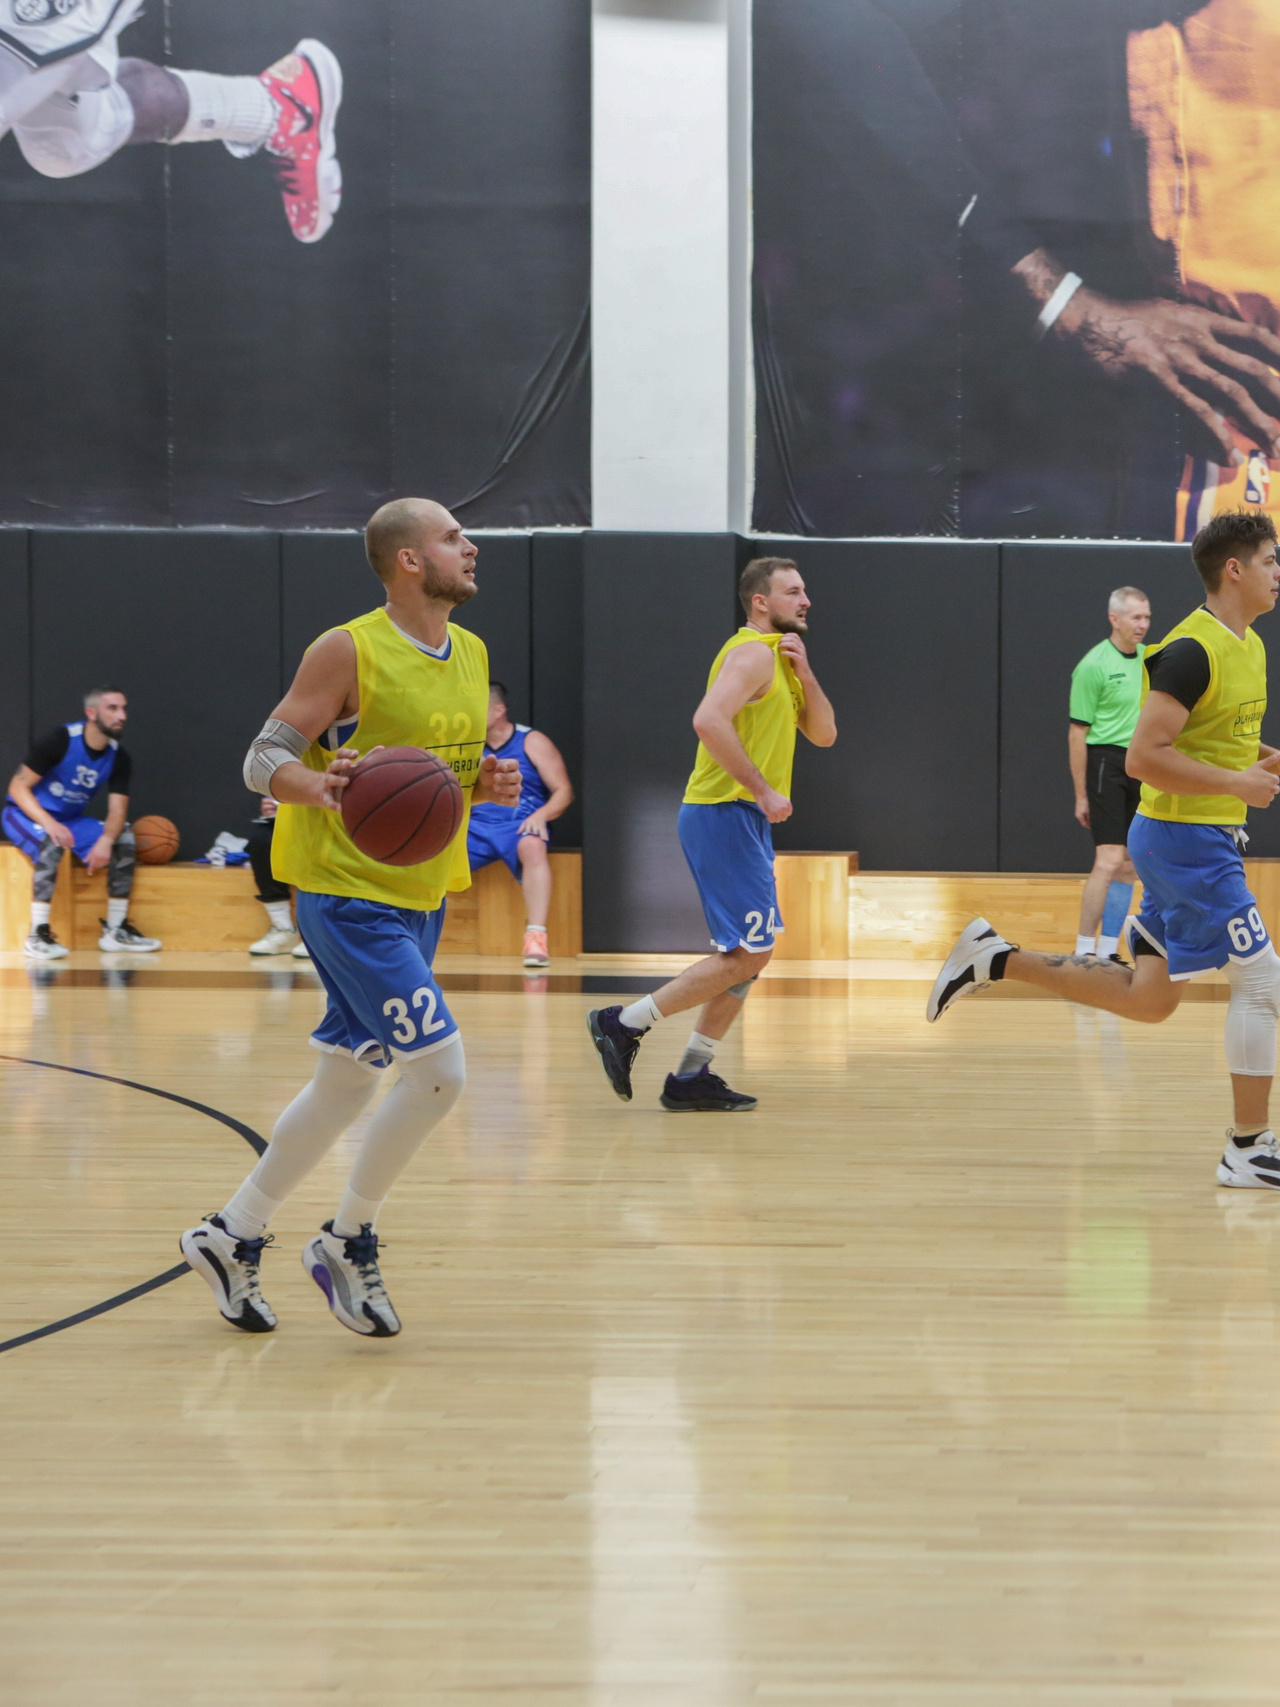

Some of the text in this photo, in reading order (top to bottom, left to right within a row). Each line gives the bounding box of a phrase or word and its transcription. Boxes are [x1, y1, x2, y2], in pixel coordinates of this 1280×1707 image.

[428, 711, 472, 760] 32
[745, 906, 776, 943] 24
[1227, 907, 1267, 952] 69
[382, 986, 447, 1045] 32
